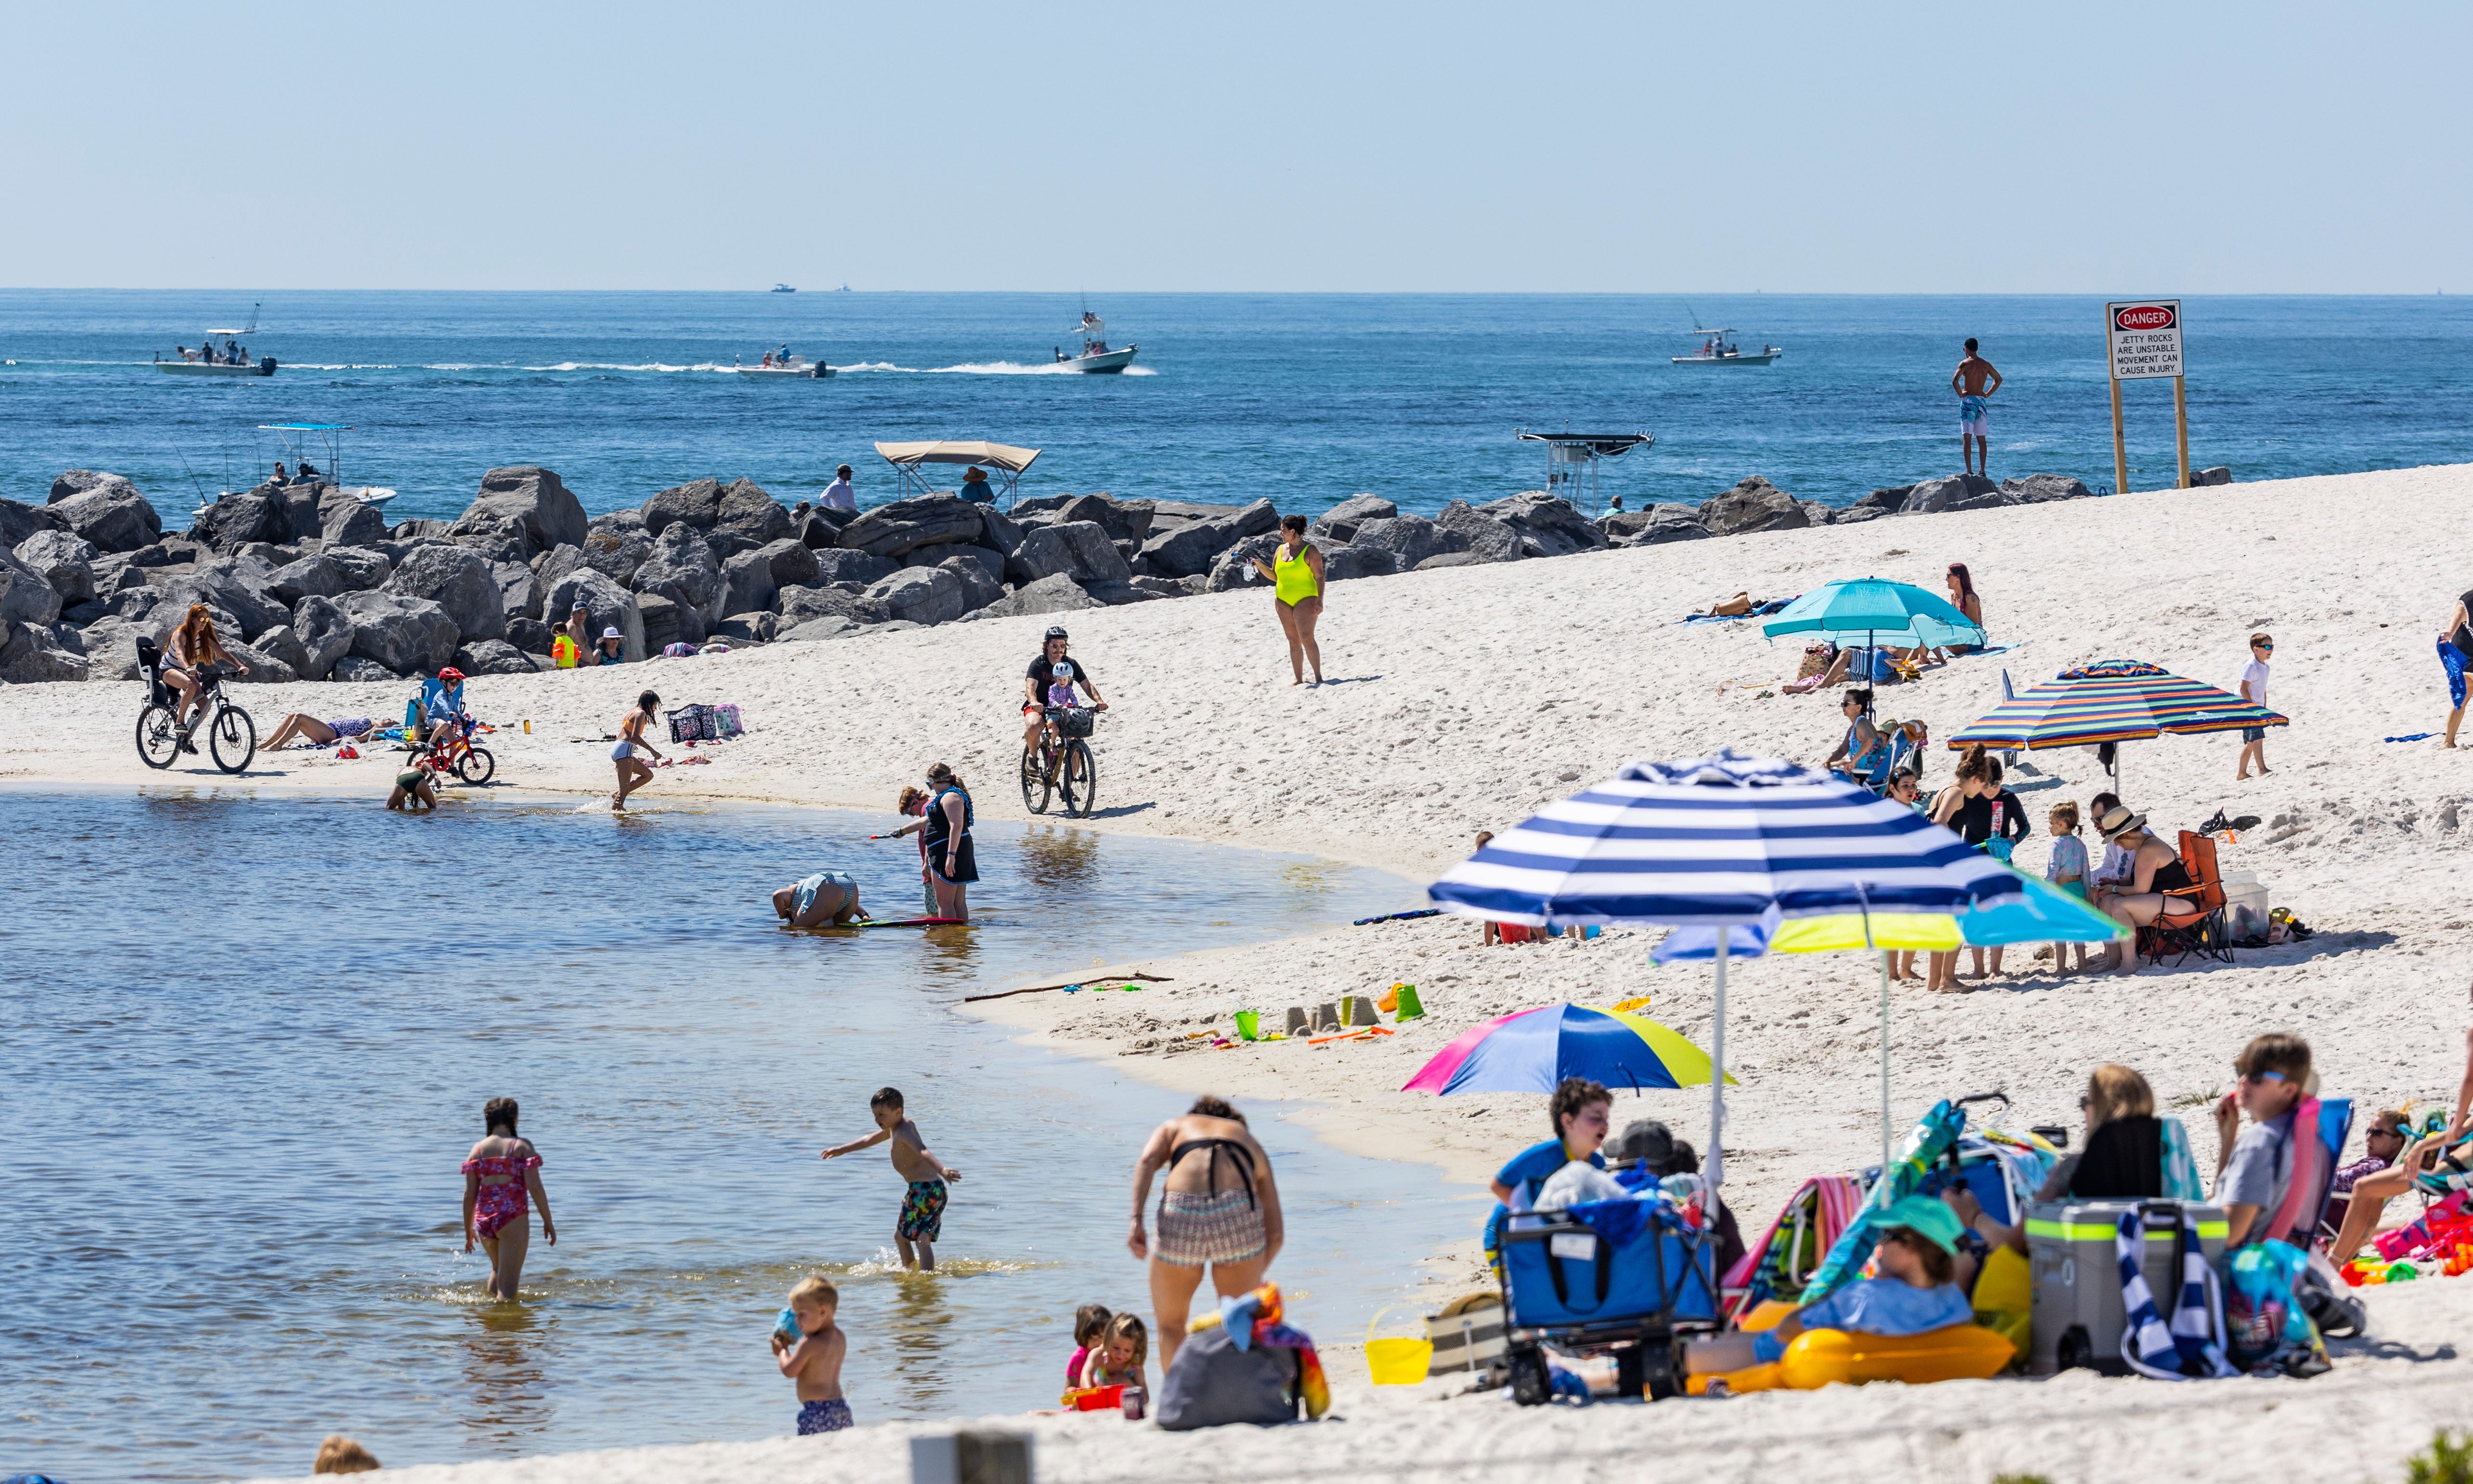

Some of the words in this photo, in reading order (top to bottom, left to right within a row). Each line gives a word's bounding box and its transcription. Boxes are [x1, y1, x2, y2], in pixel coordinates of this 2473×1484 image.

[2124, 312, 2166, 324] DANGER
[2121, 335, 2144, 344] JETTY
[2148, 334, 2172, 343] ROCKS
[2136, 344, 2177, 353] UNSTABLE.
[2117, 355, 2158, 364] MOVEMENT
[2162, 354, 2178, 362] CAN
[2121, 366, 2145, 374] CAUSE
[2148, 365, 2176, 373] INJURY.
